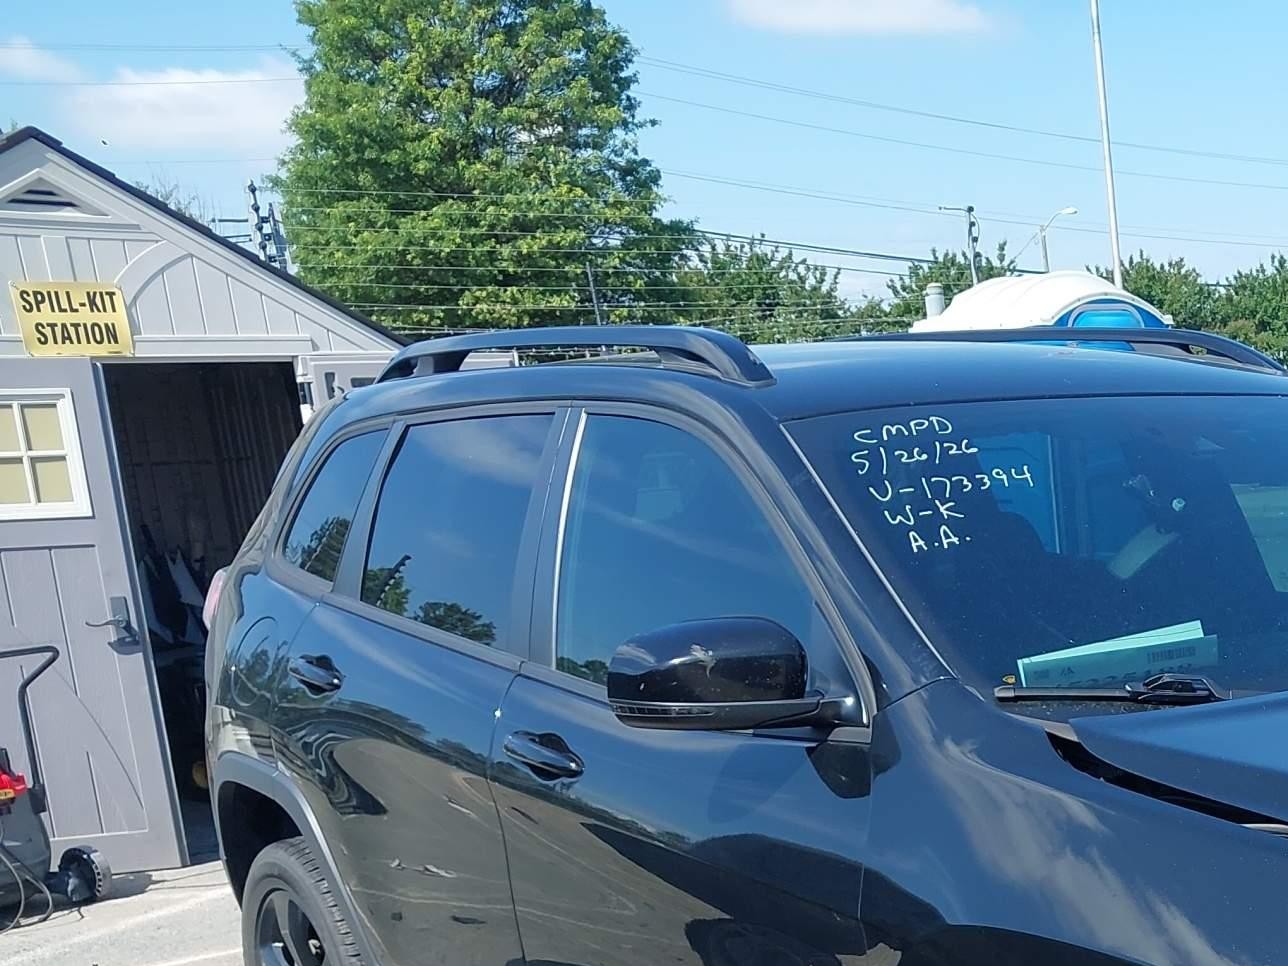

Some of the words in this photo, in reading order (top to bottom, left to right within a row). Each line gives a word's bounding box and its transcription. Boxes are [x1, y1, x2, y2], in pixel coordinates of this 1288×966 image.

[20, 289, 117, 313] SPILL-KIT
[34, 322, 119, 345] STATION
[853, 416, 953, 443] CMPD
[851, 439, 978, 475] 5/26/26
[884, 500, 965, 525] W-K
